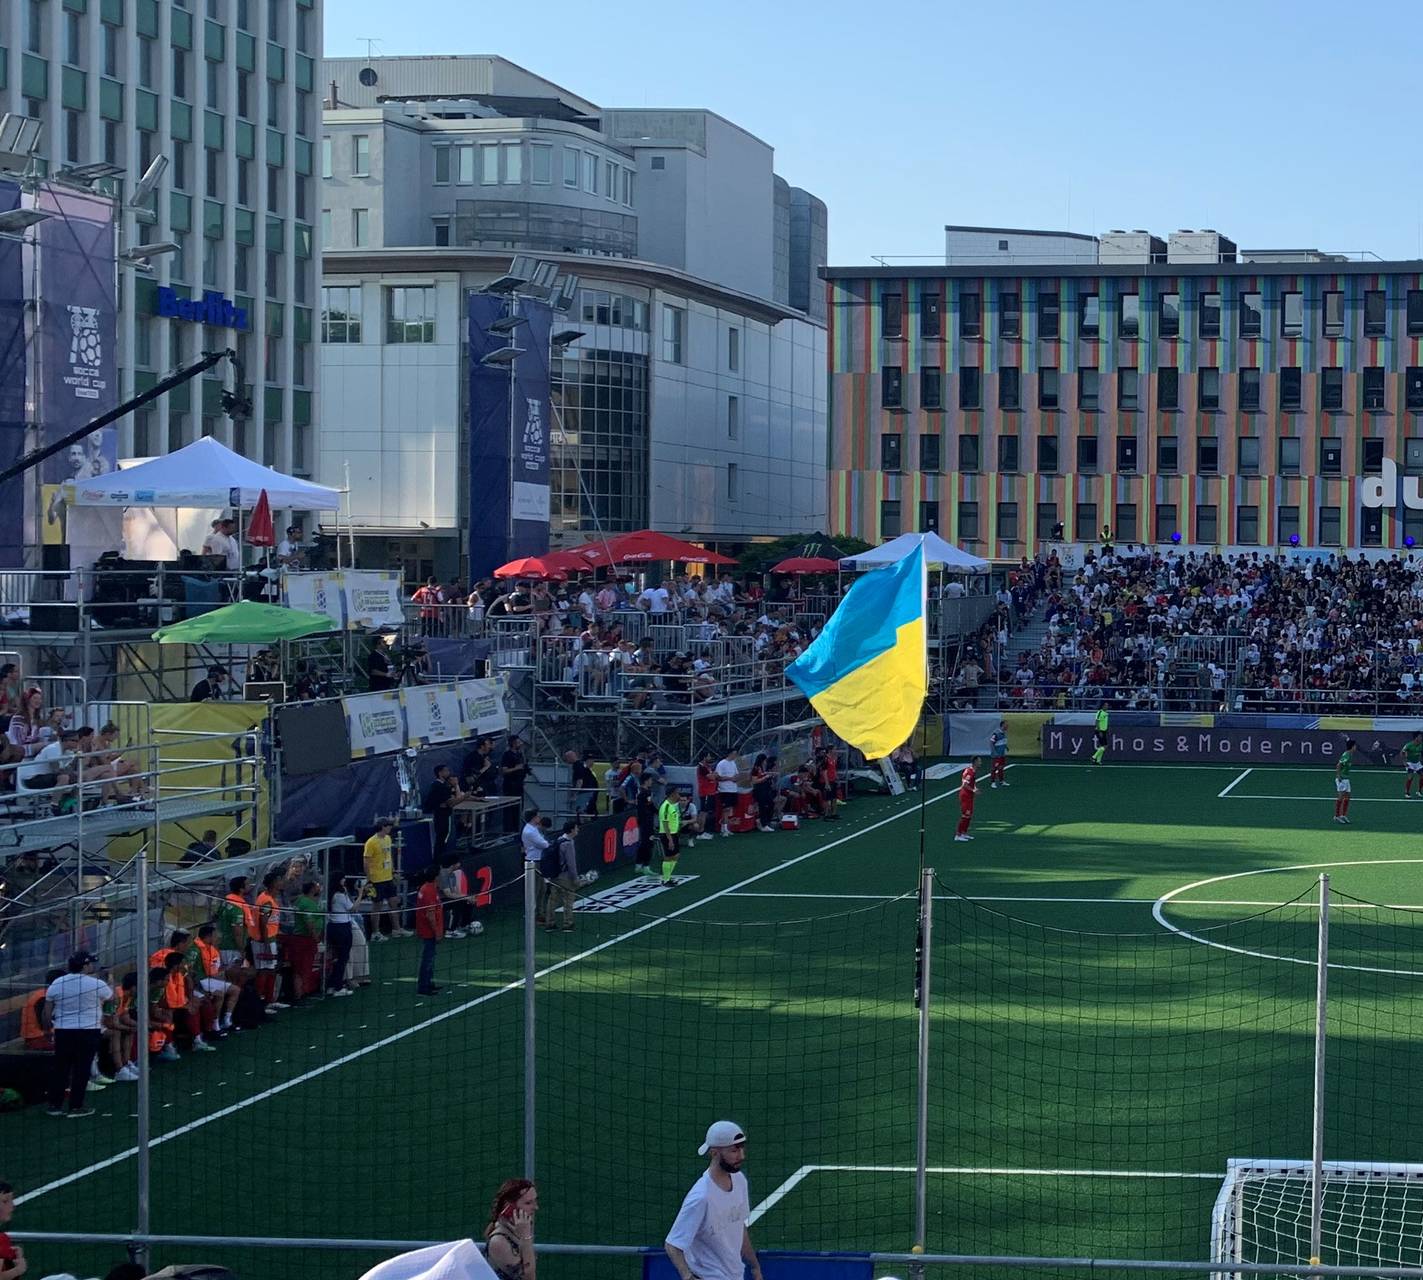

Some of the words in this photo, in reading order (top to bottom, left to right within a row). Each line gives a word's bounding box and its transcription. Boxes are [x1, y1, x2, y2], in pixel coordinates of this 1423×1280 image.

[157, 286, 248, 331] Berlitz
[64, 376, 89, 387] world
[603, 827, 617, 863] 0
[473, 866, 491, 907] 2
